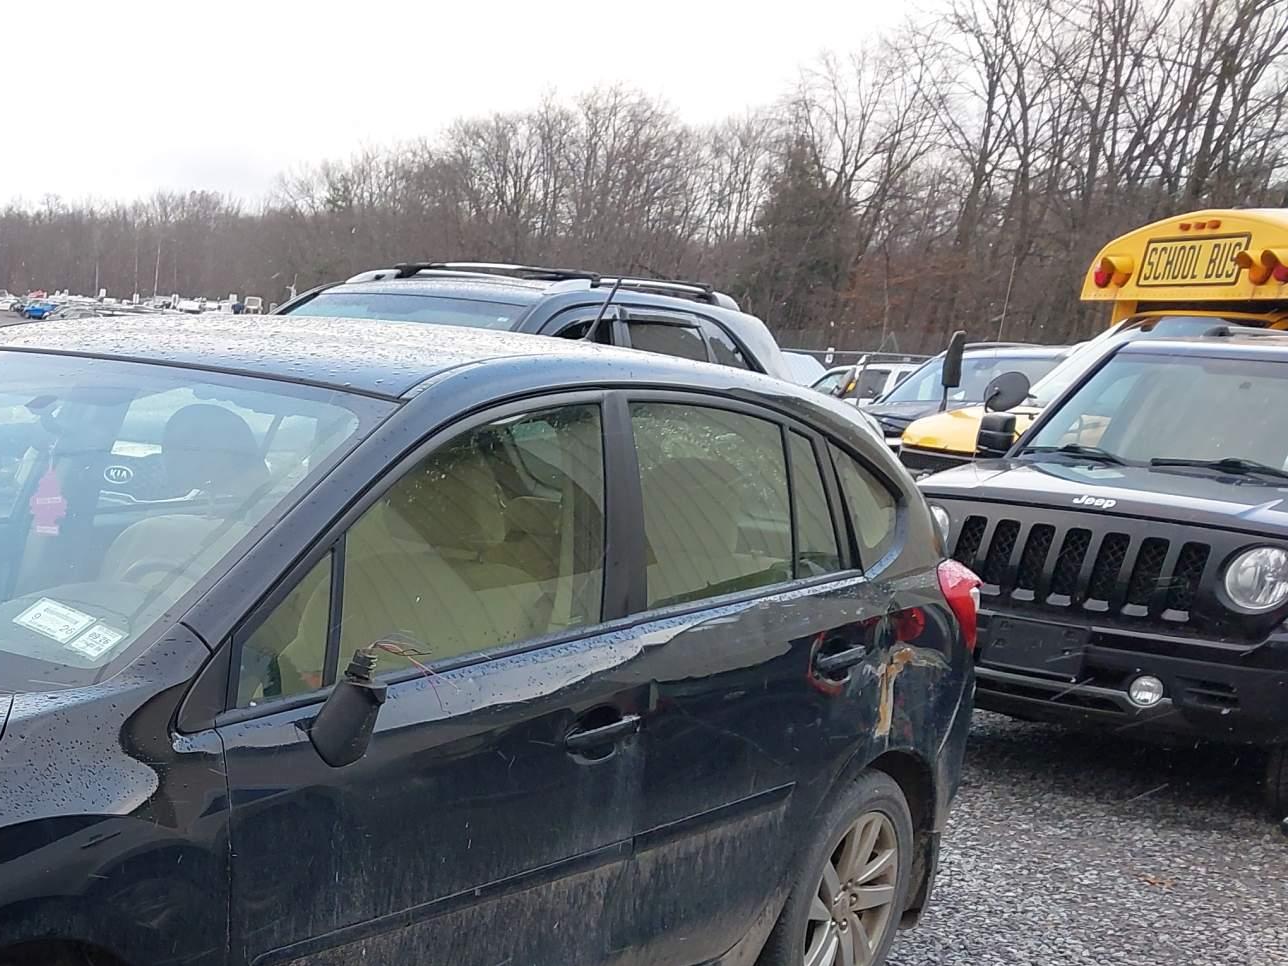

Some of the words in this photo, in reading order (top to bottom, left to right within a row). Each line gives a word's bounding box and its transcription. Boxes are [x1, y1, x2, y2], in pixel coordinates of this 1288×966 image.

[1143, 245, 1203, 281] SCHOOL
[1205, 242, 1242, 280] BUS
[109, 468, 128, 480] KIA
[1072, 495, 1117, 509] Jeep
